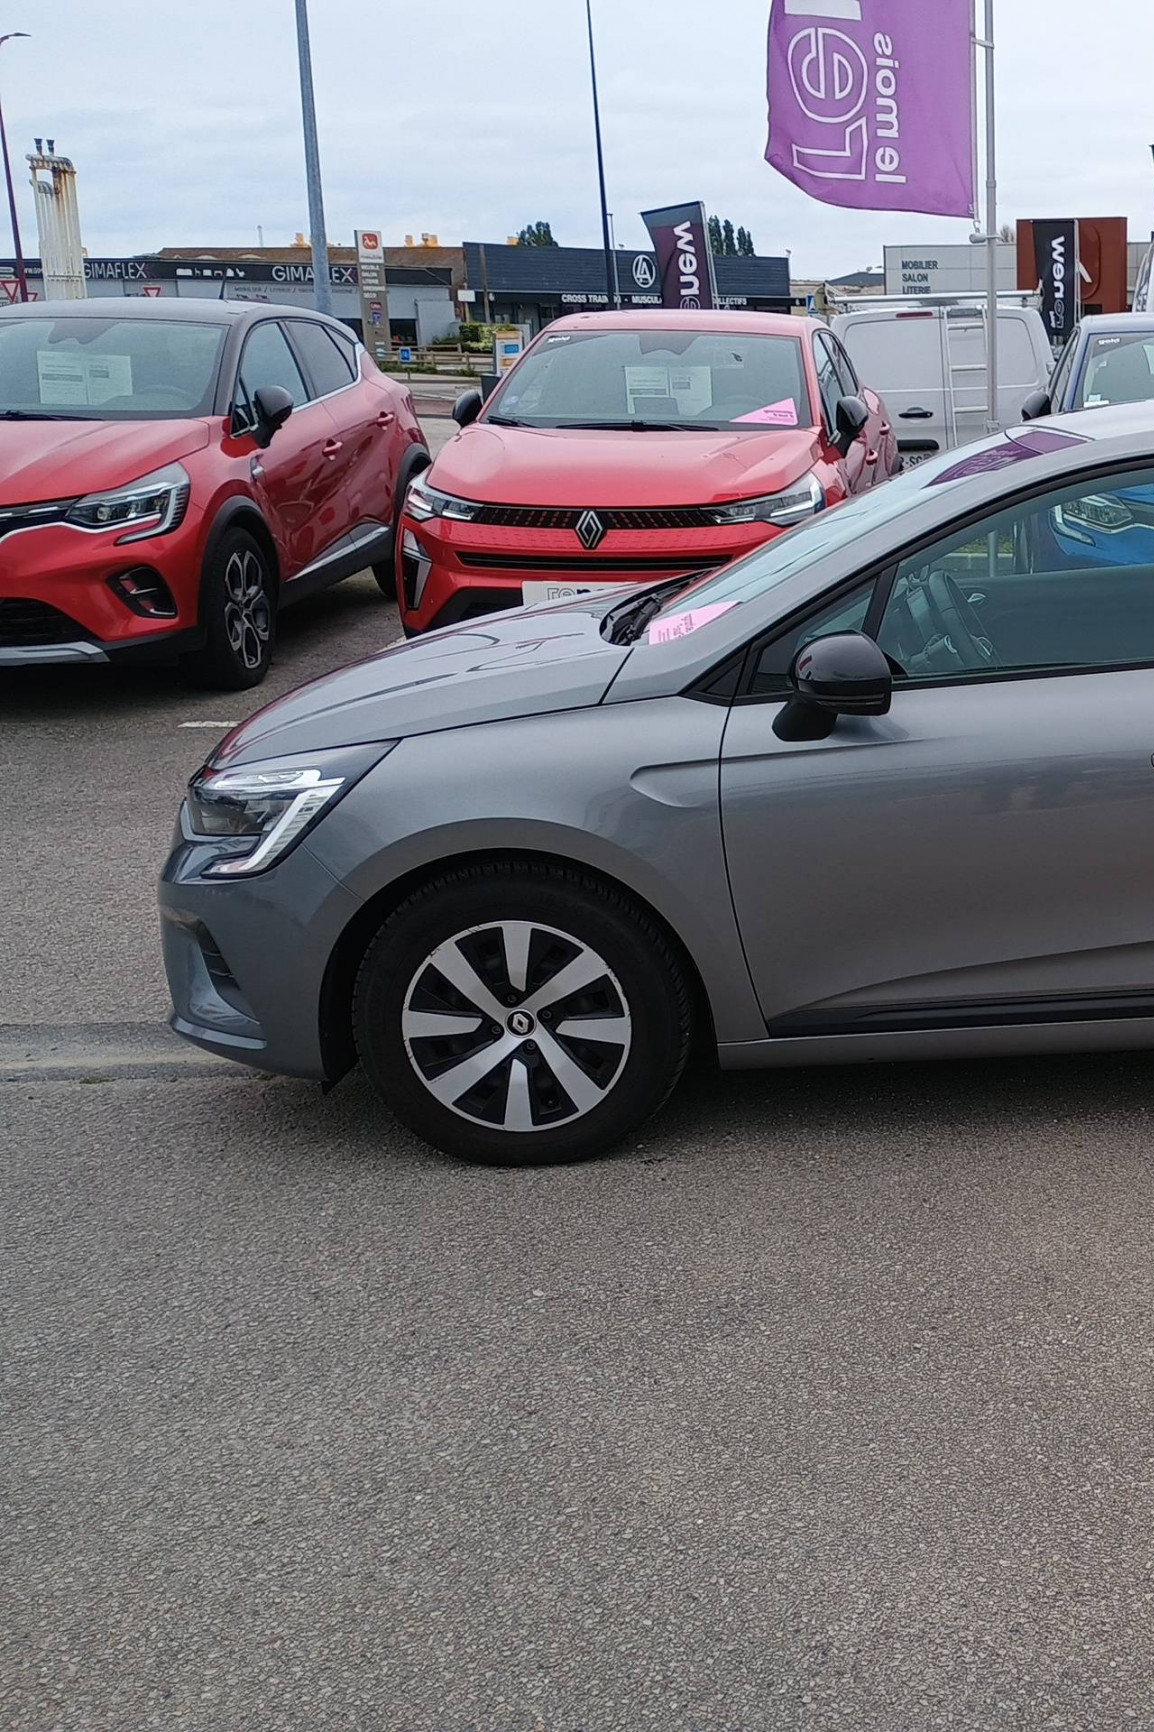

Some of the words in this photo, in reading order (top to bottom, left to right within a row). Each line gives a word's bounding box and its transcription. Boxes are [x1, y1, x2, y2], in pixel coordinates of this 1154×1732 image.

[901, 260, 938, 270] MOBILIER
[84, 263, 147, 279] GIMAFLEX
[272, 265, 354, 283] GIMAEX
[902, 273, 928, 282] SALON
[902, 286, 931, 294] LITERIE
[561, 294, 586, 303] CROSS
